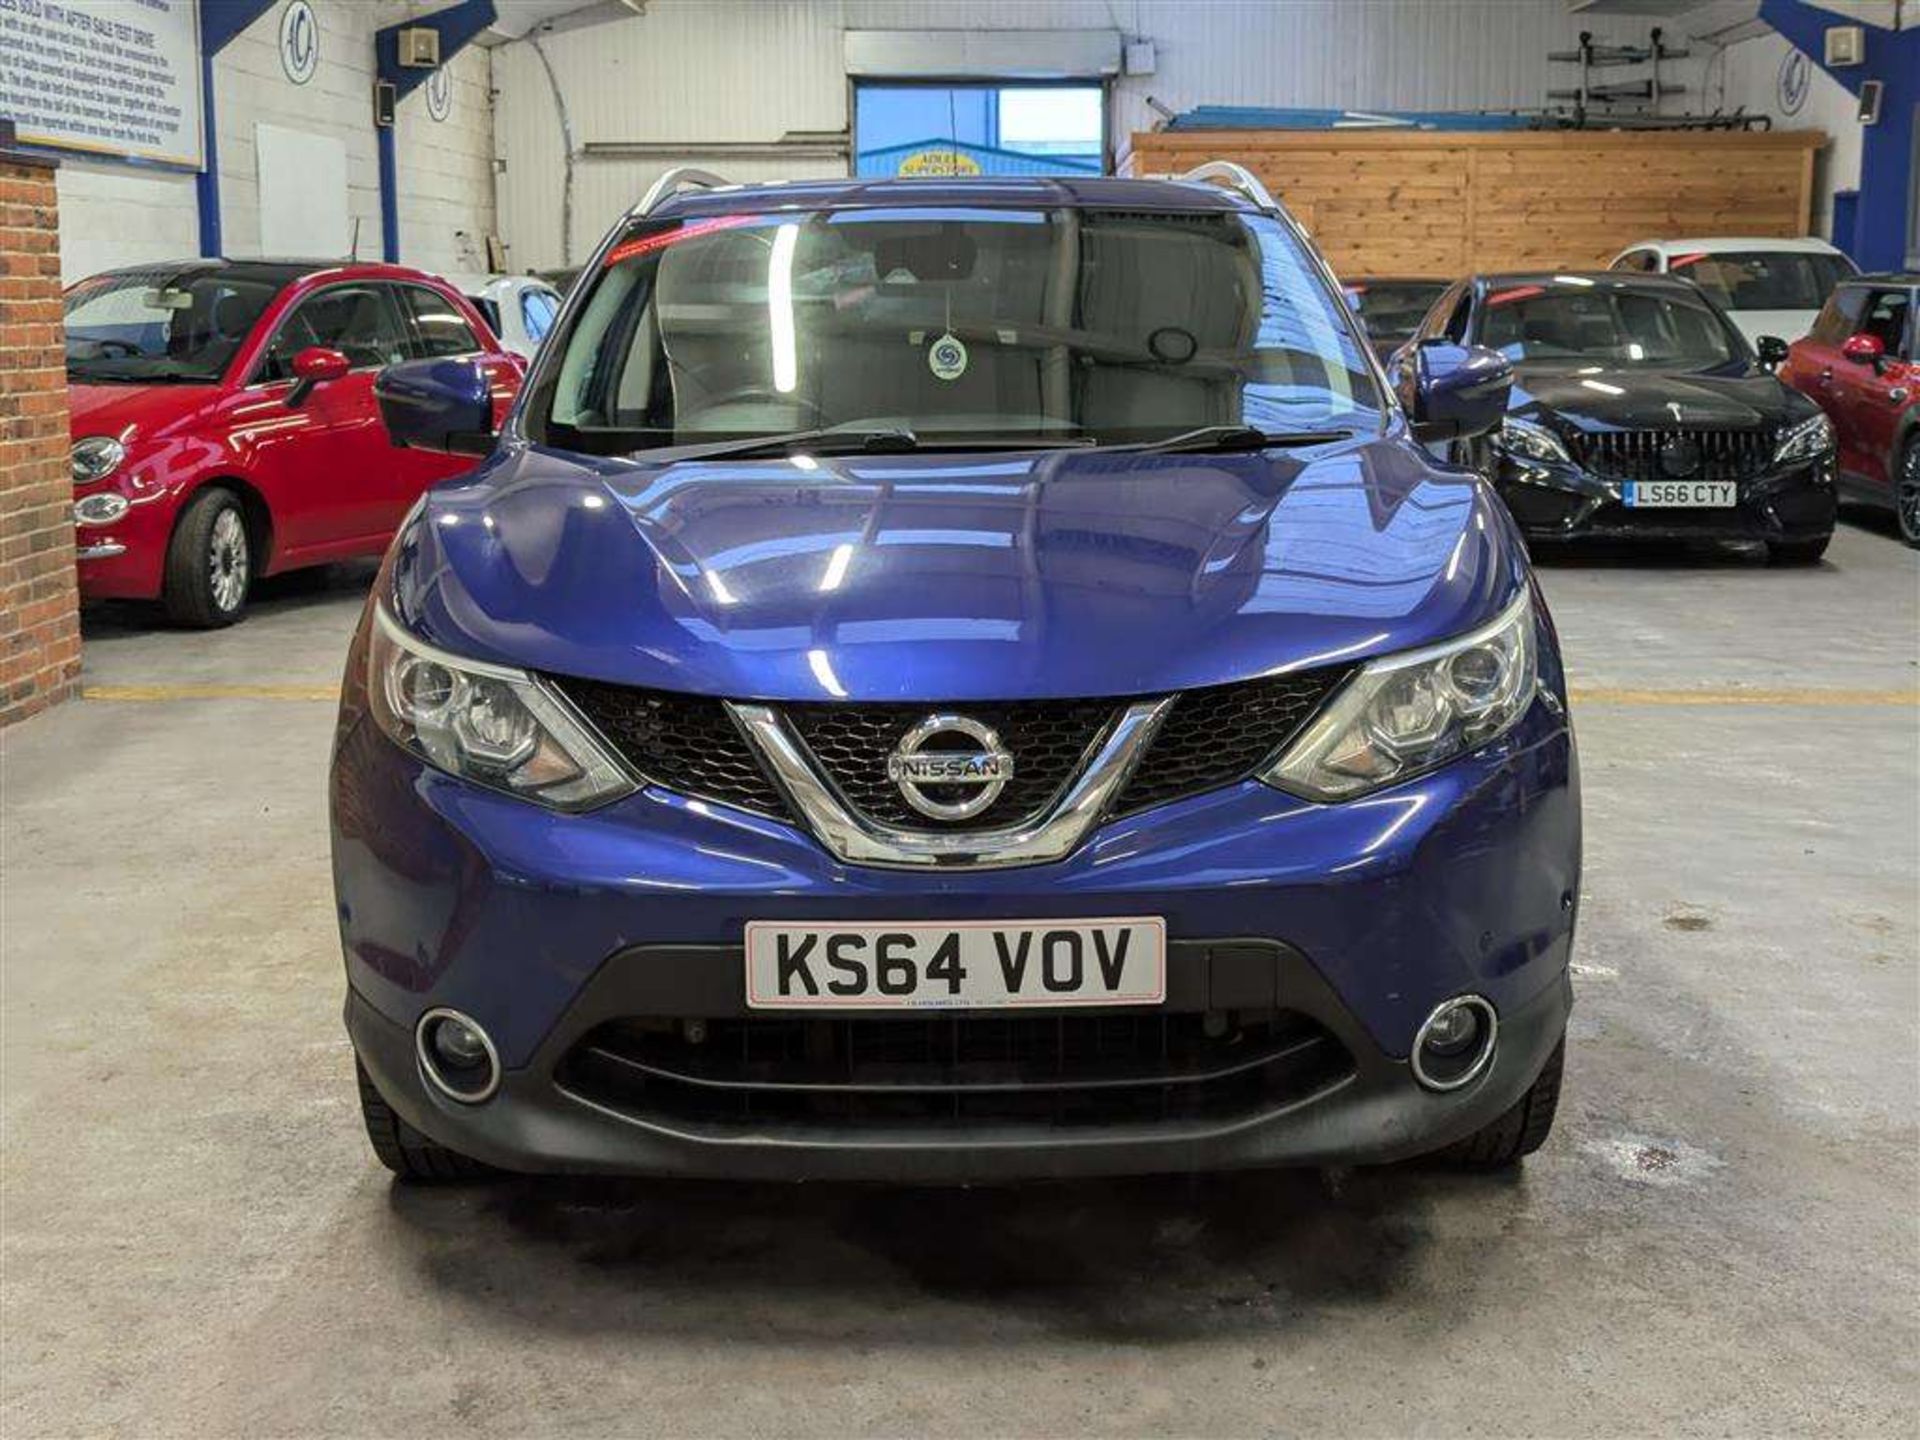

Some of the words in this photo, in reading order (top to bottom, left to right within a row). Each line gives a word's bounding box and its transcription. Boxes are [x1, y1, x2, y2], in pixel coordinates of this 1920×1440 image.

[67, 9, 91, 31] AFTER
[92, 16, 113, 38] SALE
[114, 22, 132, 42] TEST
[1637, 485, 1689, 503] LS66
[1694, 485, 1731, 503] CTY
[902, 760, 999, 777] NISSAN
[777, 933, 967, 996] KS64
[993, 928, 1131, 993] VOV
